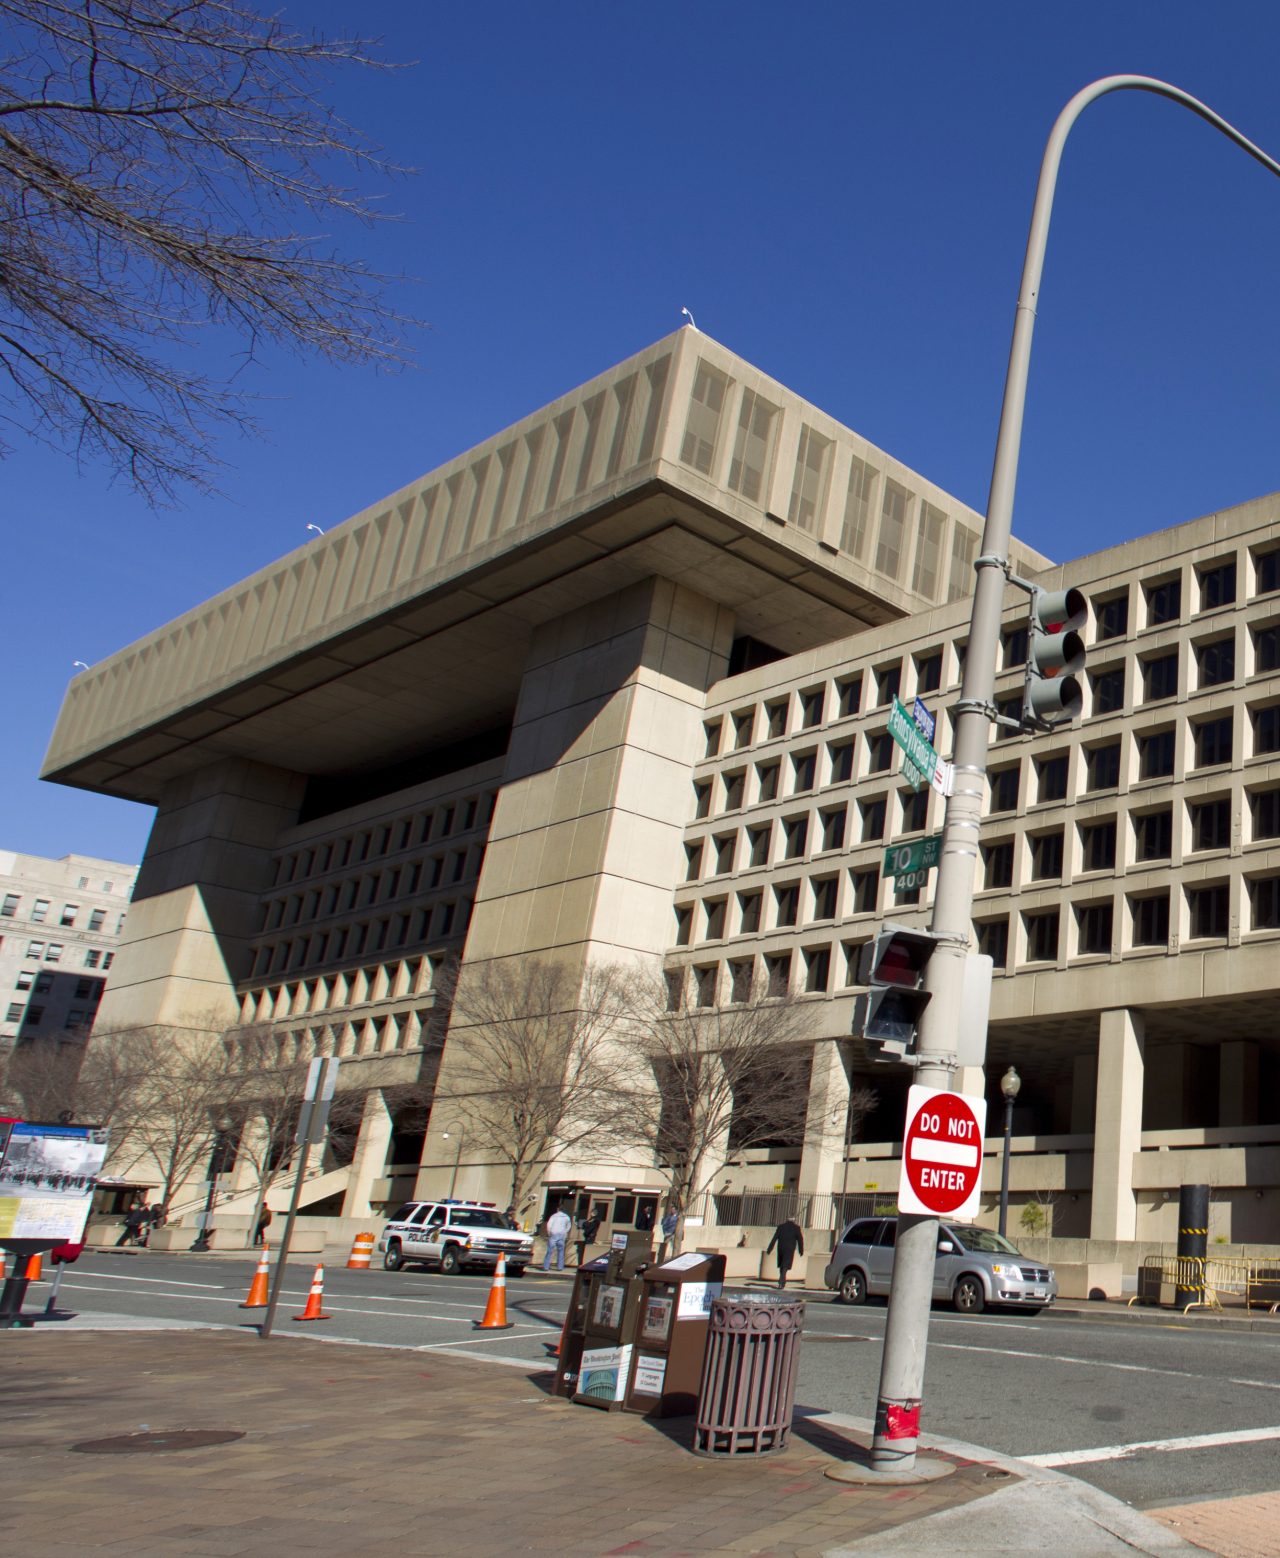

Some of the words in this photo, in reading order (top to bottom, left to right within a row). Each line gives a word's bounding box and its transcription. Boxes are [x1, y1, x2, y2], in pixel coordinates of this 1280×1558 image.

[890, 698, 930, 770] Pennsylvania
[904, 758, 920, 786] 1000
[925, 841, 938, 853] ST
[891, 847, 911, 871] 10
[922, 852, 937, 865] NW
[897, 870, 926, 889] 400
[920, 1113, 940, 1133] DO
[948, 1117, 974, 1139] NOT
[920, 1168, 965, 1191] ENTER
[408, 1232, 431, 1243] POLICE
[683, 1289, 715, 1305] Epoch
